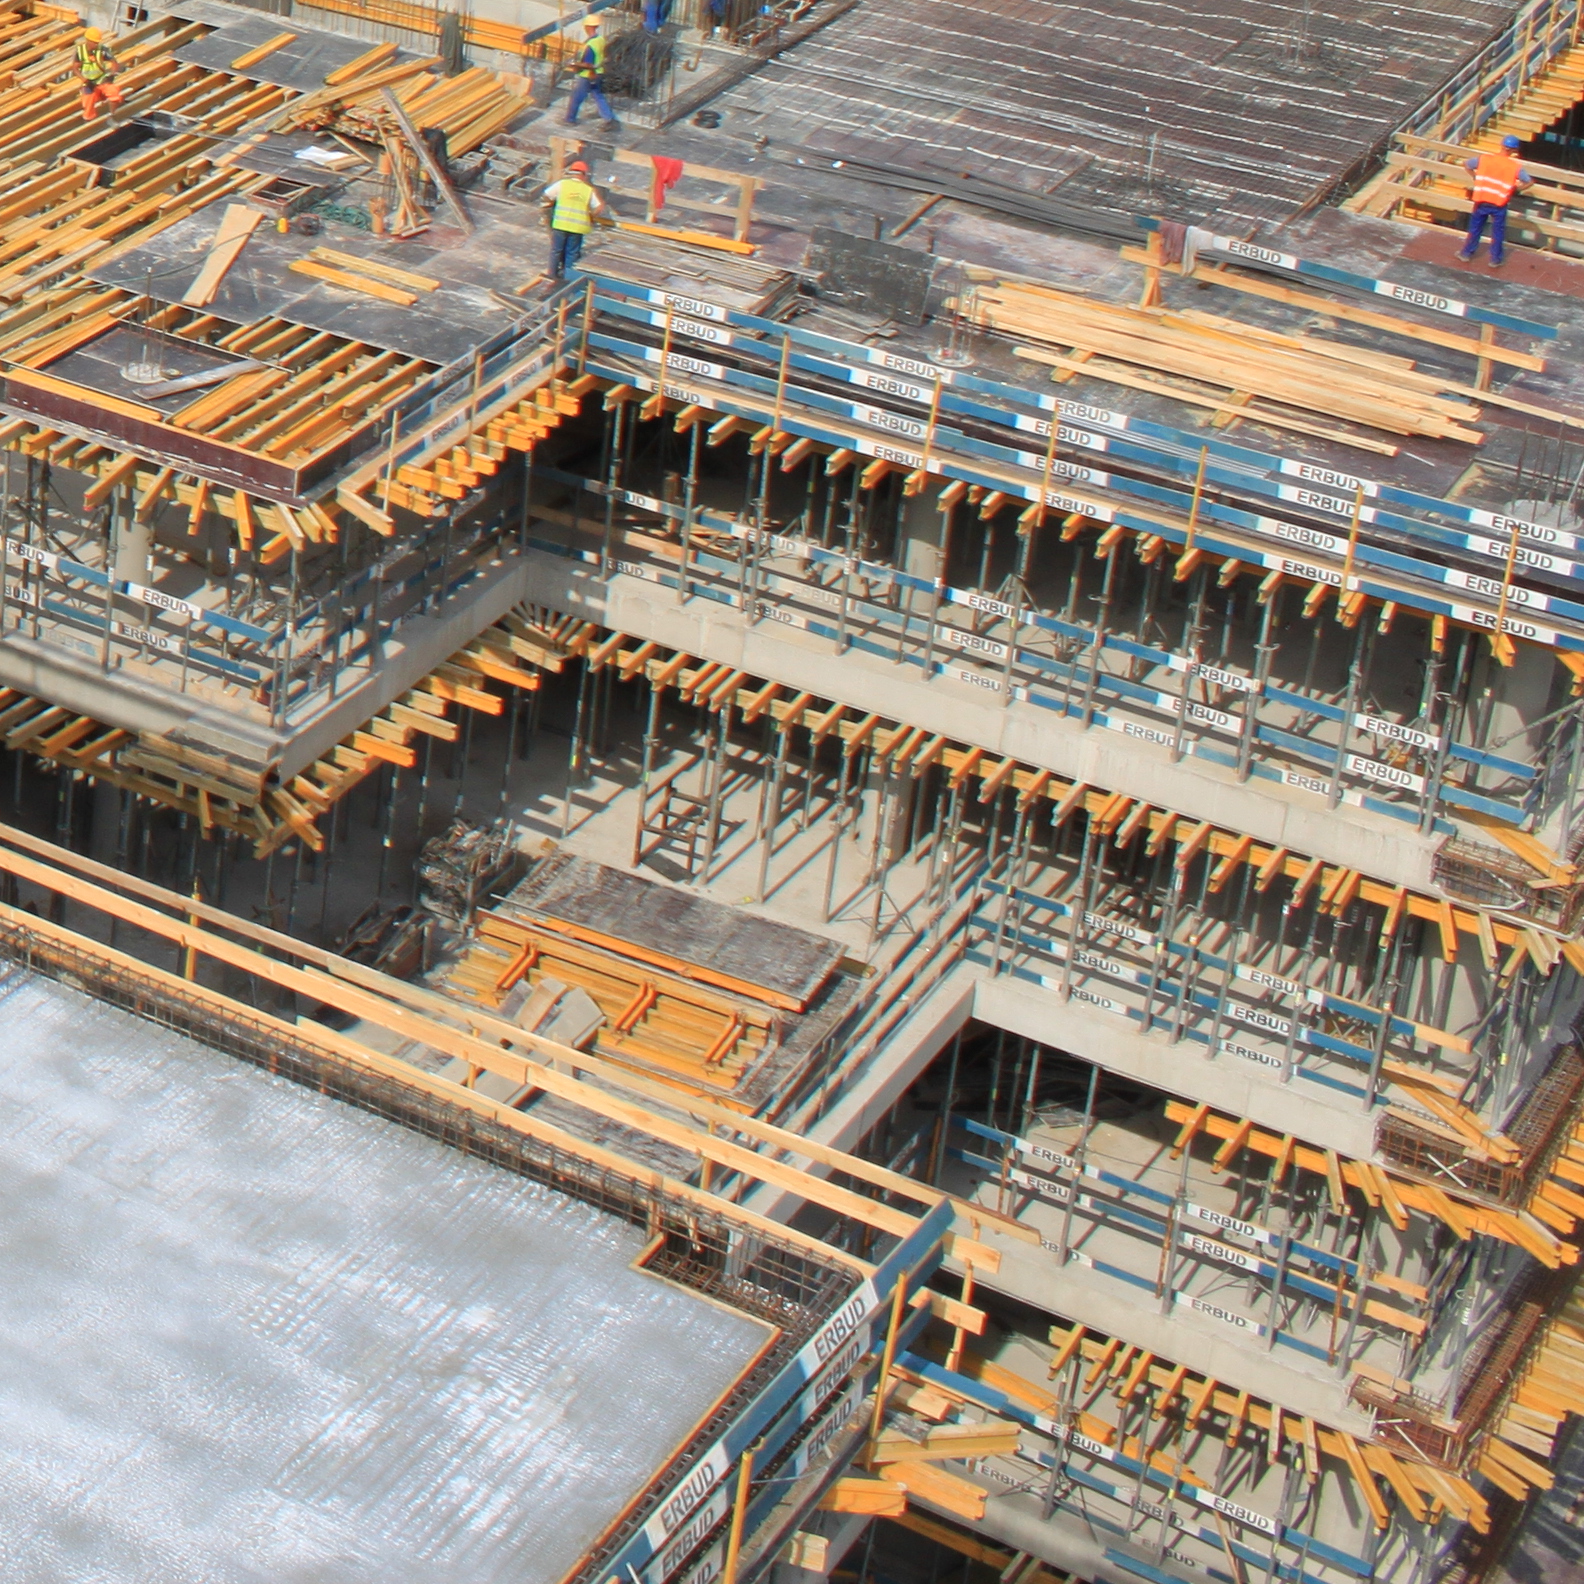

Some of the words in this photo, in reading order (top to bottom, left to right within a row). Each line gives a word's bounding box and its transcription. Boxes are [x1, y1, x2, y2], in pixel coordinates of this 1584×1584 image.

[1228, 241, 1281, 264] ERBUD
[664, 295, 714, 317] ERBUD
[1392, 285, 1448, 310] ERBUD
[884, 355, 938, 378] ERBUD
[867, 376, 920, 399] ERBUD
[868, 412, 921, 435] ERBUD
[1054, 399, 1111, 423] ERBUD
[1299, 465, 1360, 491] ERBUD
[1275, 523, 1335, 549] ERBUD
[1492, 516, 1556, 542] ERBUD
[1488, 542, 1553, 569] ERBUD
[1282, 560, 1342, 584] ERBUD
[142, 589, 190, 614] ERBUD
[1465, 575, 1529, 603] ERBUD
[122, 624, 168, 648] ERBUD
[950, 631, 1002, 656] ERBUD
[1365, 718, 1426, 745] ERBUD
[1352, 758, 1412, 786] ERBUD
[1083, 911, 1136, 937] ERBUD
[1069, 988, 1112, 1010] RBUD
[1234, 1007, 1290, 1034] ERBUD
[1226, 1043, 1282, 1068] ERBUD
[1032, 1145, 1075, 1169] ERBU
[1199, 1208, 1255, 1237] ERBUD
[1192, 1237, 1247, 1266] ERBUD
[1192, 1299, 1247, 1328] ERBUD
[815, 1296, 866, 1362] ERBUD
[815, 1341, 860, 1405] ERBUD
[807, 1398, 852, 1462] ERBUD
[661, 1462, 715, 1534] ERBUD
[1213, 1497, 1269, 1530] ERBUD
[662, 1508, 714, 1579] ERBUD
